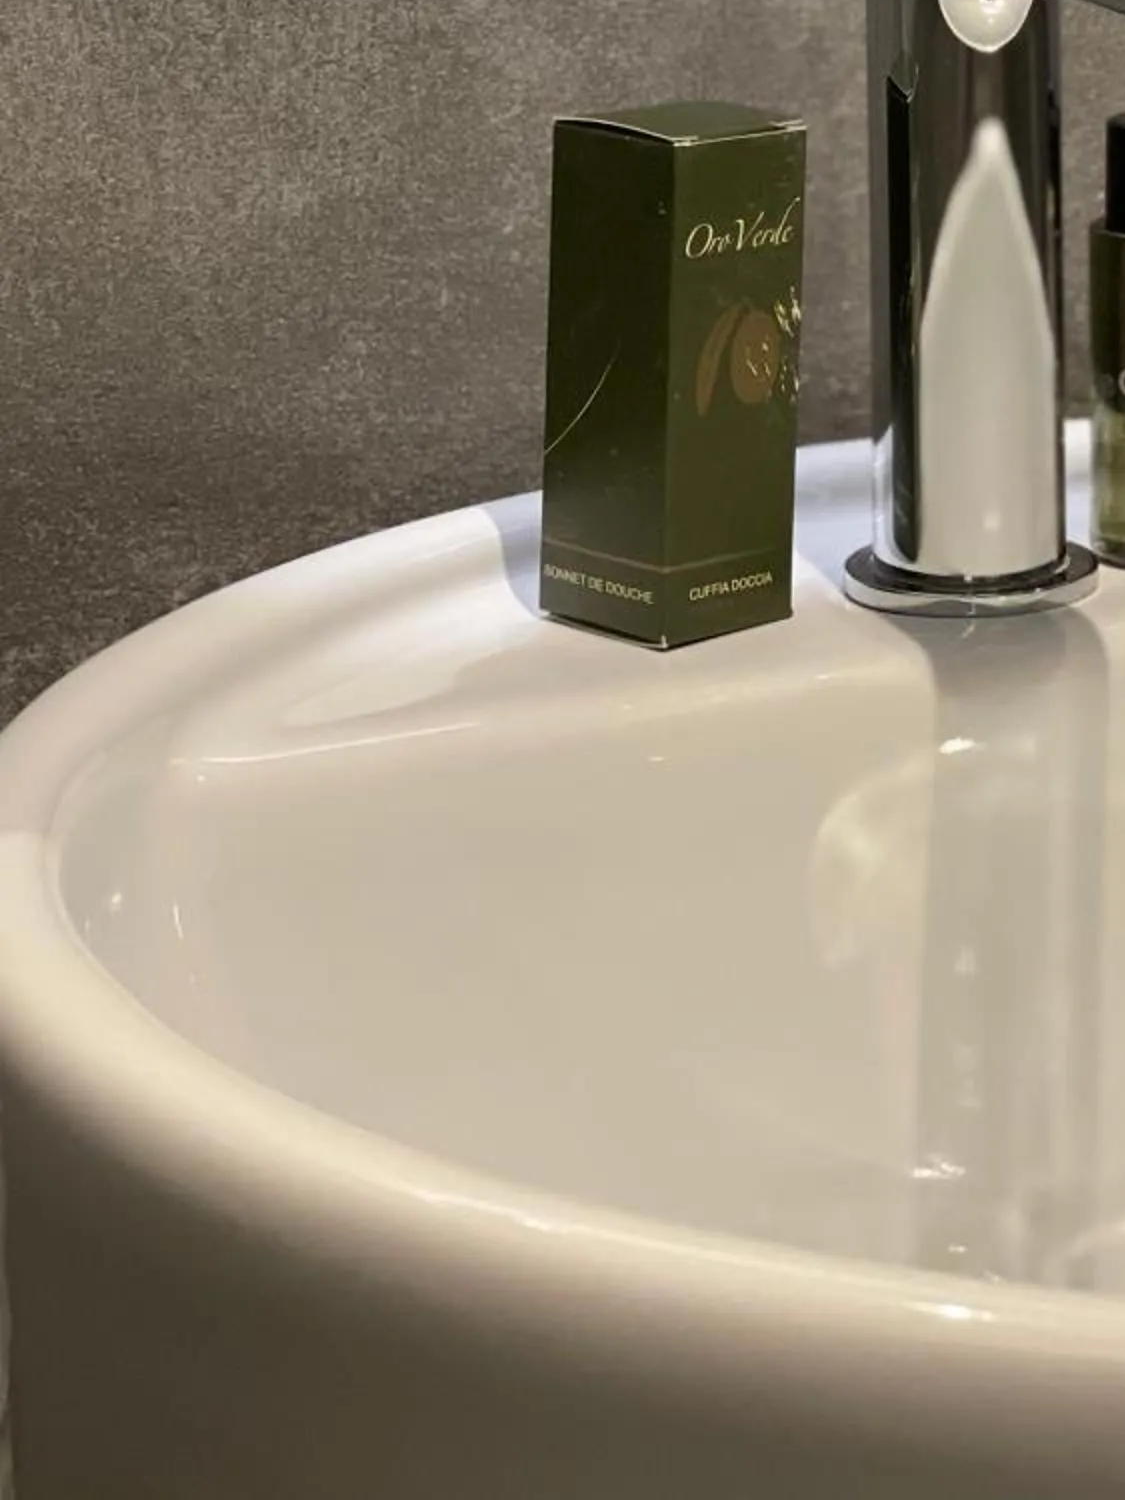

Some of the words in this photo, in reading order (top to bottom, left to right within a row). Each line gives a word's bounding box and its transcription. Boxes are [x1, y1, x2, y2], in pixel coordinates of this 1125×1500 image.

[685, 223, 733, 259] Oro
[735, 197, 801, 252] Verde
[543, 563, 586, 587] BONNET
[588, 576, 603, 592] DE
[605, 581, 654, 604] DOUCHE
[689, 581, 729, 601] CUFFIA
[731, 570, 773, 592] DOCCIA
